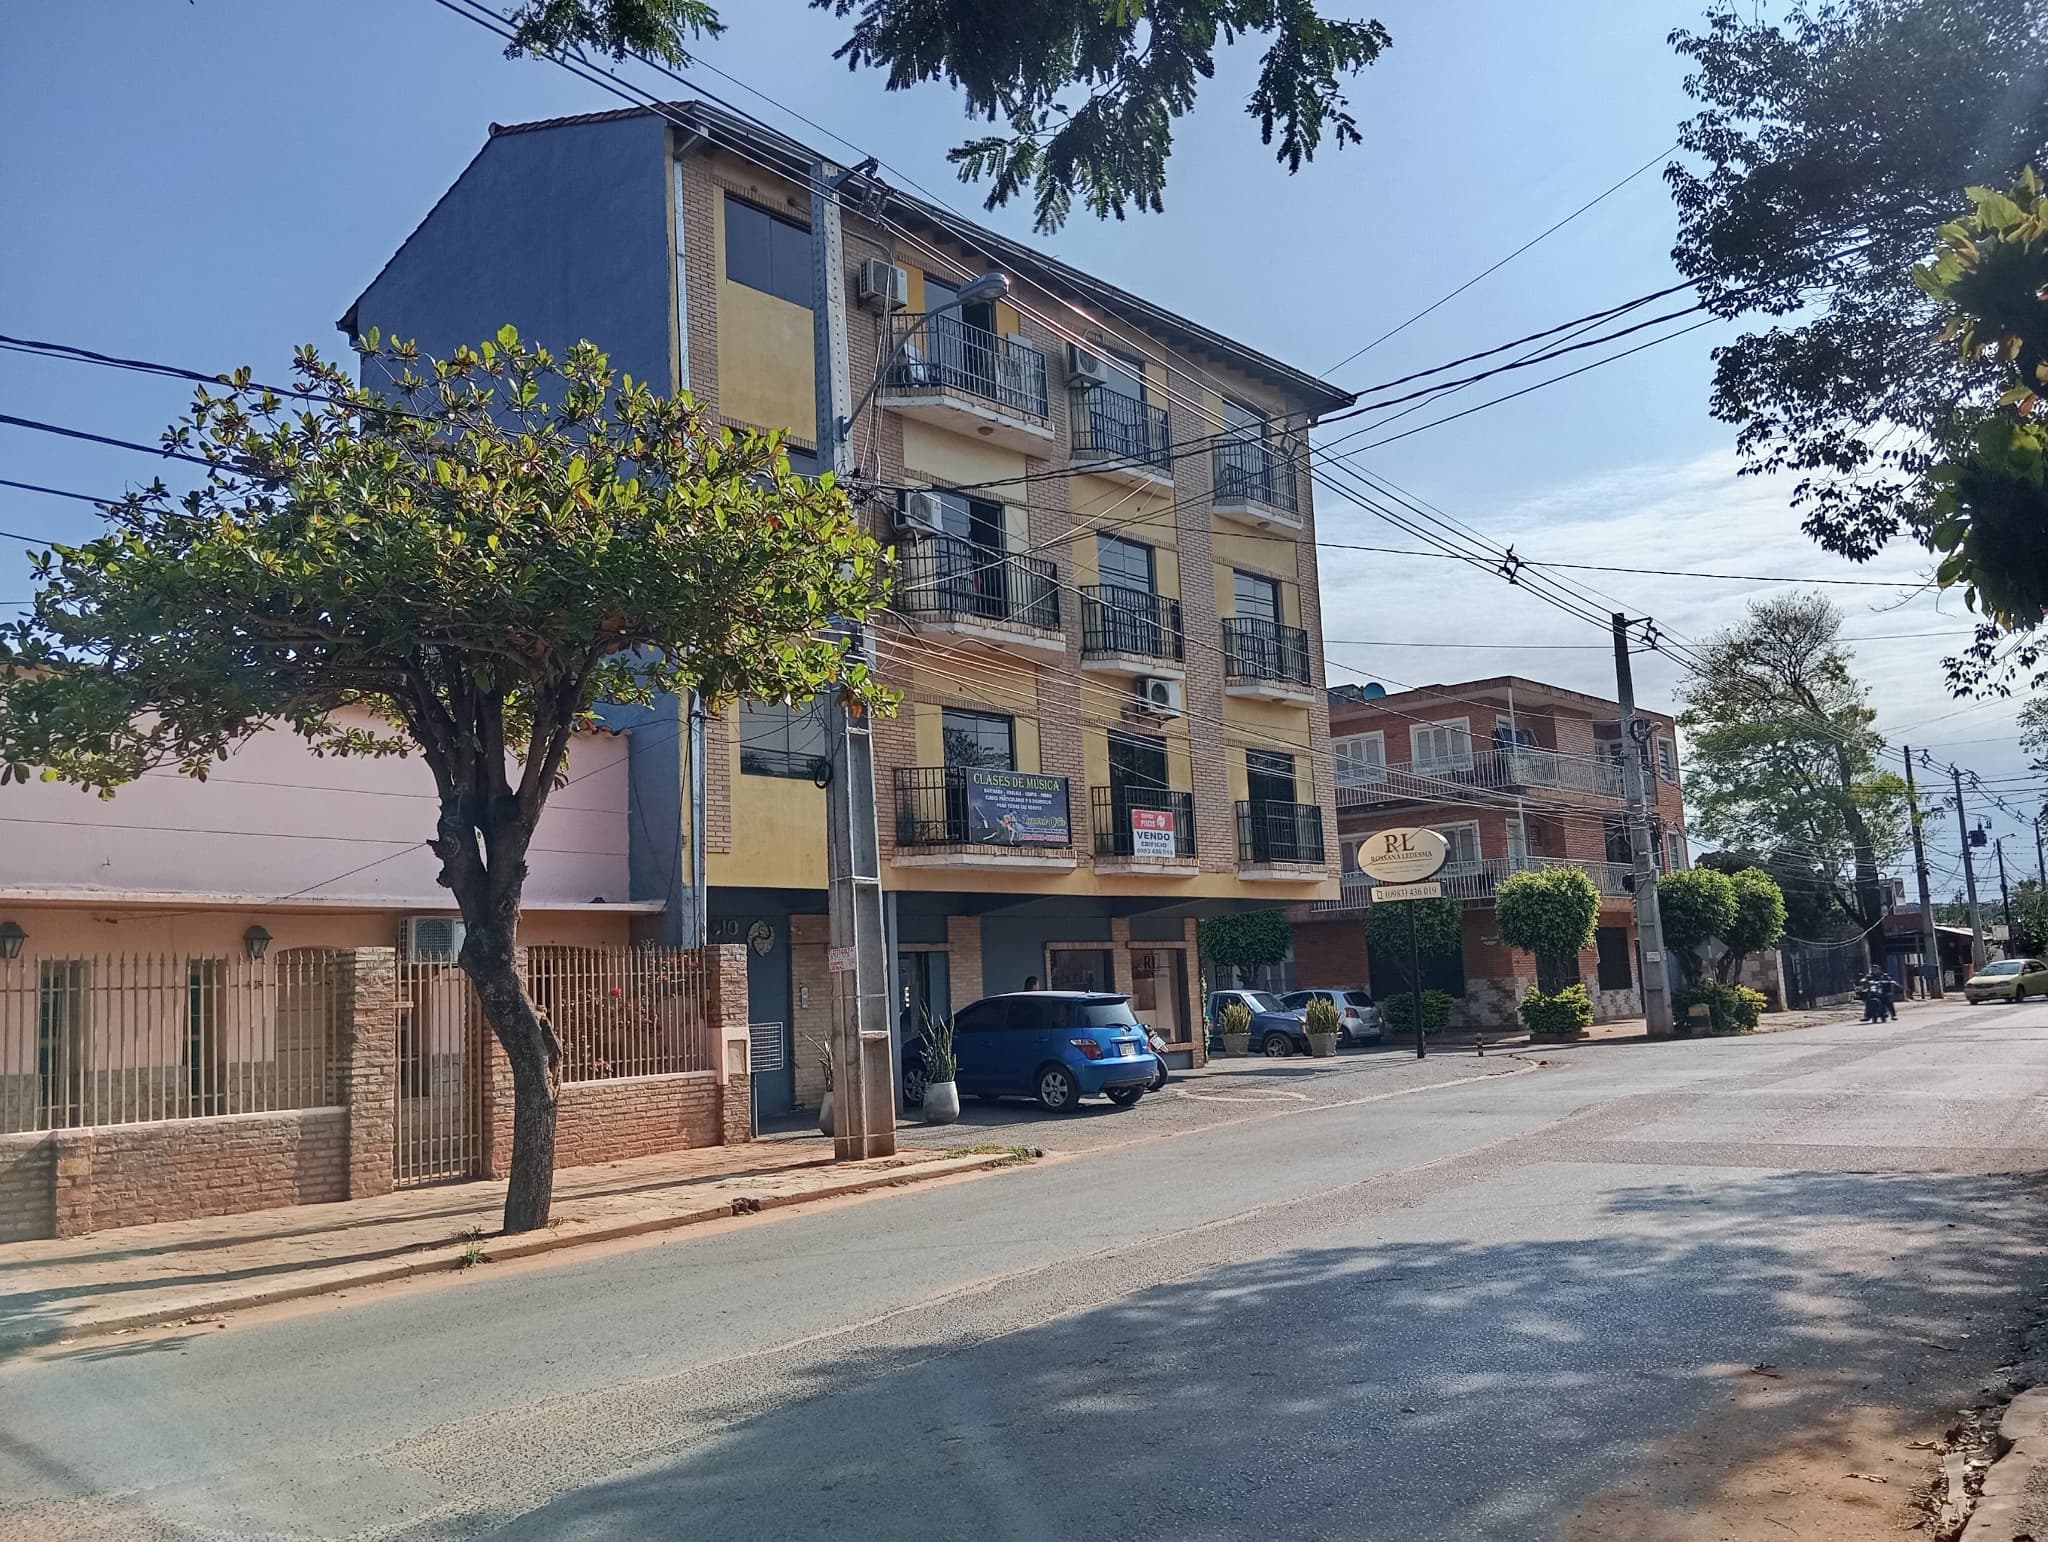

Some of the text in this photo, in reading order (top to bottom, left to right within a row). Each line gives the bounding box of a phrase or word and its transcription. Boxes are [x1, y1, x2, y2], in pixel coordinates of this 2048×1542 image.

[973, 773, 1060, 791] CLASES DE MÚSICA
[1136, 831, 1170, 841] VENDO
[1383, 833, 1415, 853] RL
[1401, 850, 1433, 860] LEDESMA
[1385, 886, 1437, 898] (0983) 436 019
